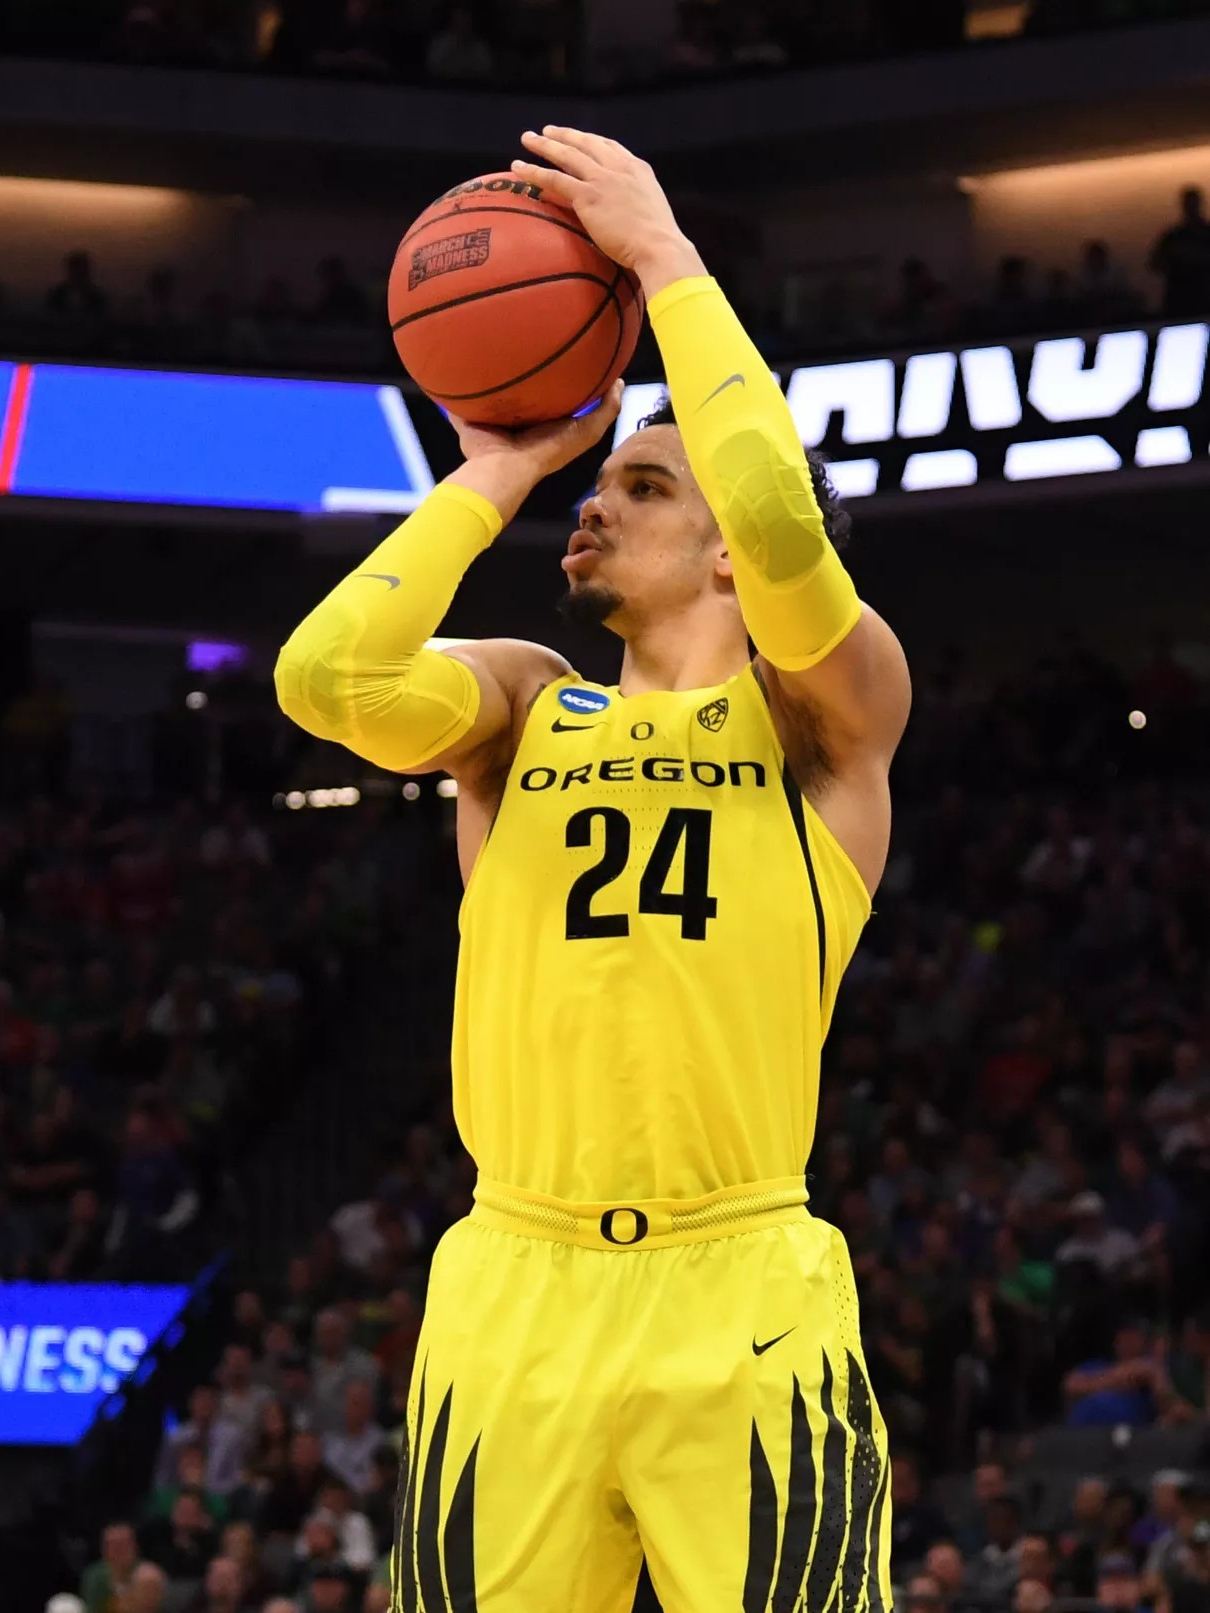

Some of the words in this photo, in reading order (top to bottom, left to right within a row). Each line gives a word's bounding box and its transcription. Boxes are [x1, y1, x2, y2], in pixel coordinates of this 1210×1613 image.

[421, 234, 467, 262] MARCH
[425, 245, 489, 274] MADNESS
[520, 757, 766, 792] OREGON
[565, 806, 717, 941] 24
